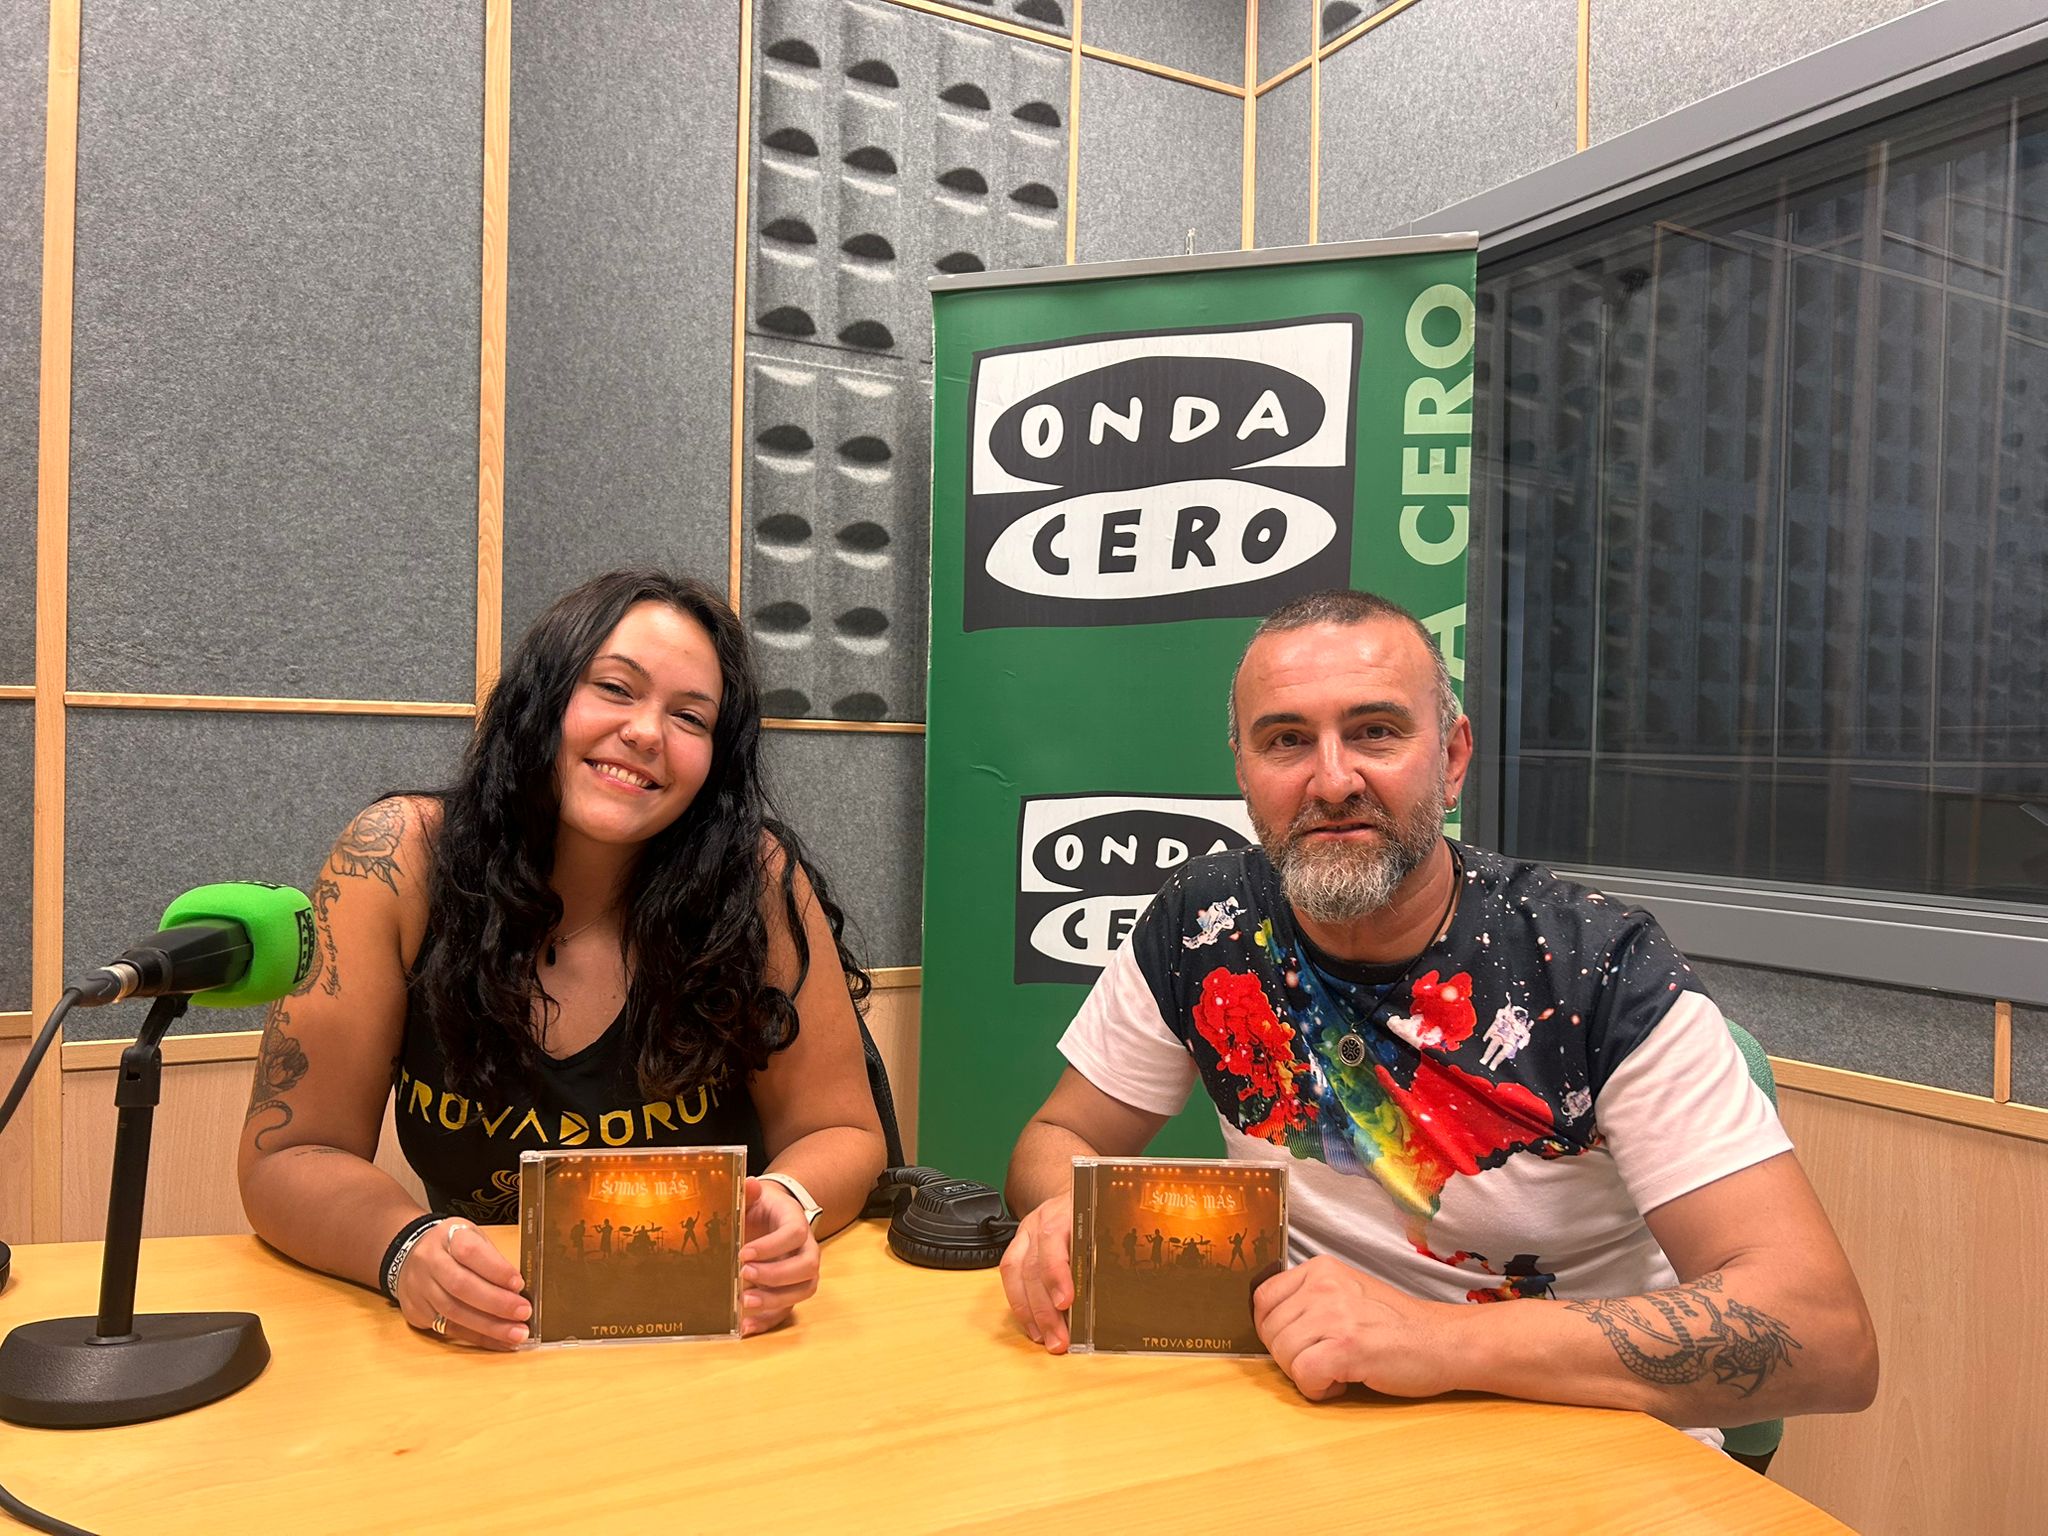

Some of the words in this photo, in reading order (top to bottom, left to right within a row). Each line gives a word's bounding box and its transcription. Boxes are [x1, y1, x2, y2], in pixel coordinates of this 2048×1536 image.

[1020, 389, 1290, 459] ONDA
[1399, 283, 1476, 566] CERO
[1032, 505, 1289, 576] CERO
[1062, 907, 1138, 951] CE
[397, 1064, 727, 1147] TROVADORU
[591, 1322, 683, 1336] TROVADORUM
[1142, 1337, 1232, 1350] TROVADORUM
